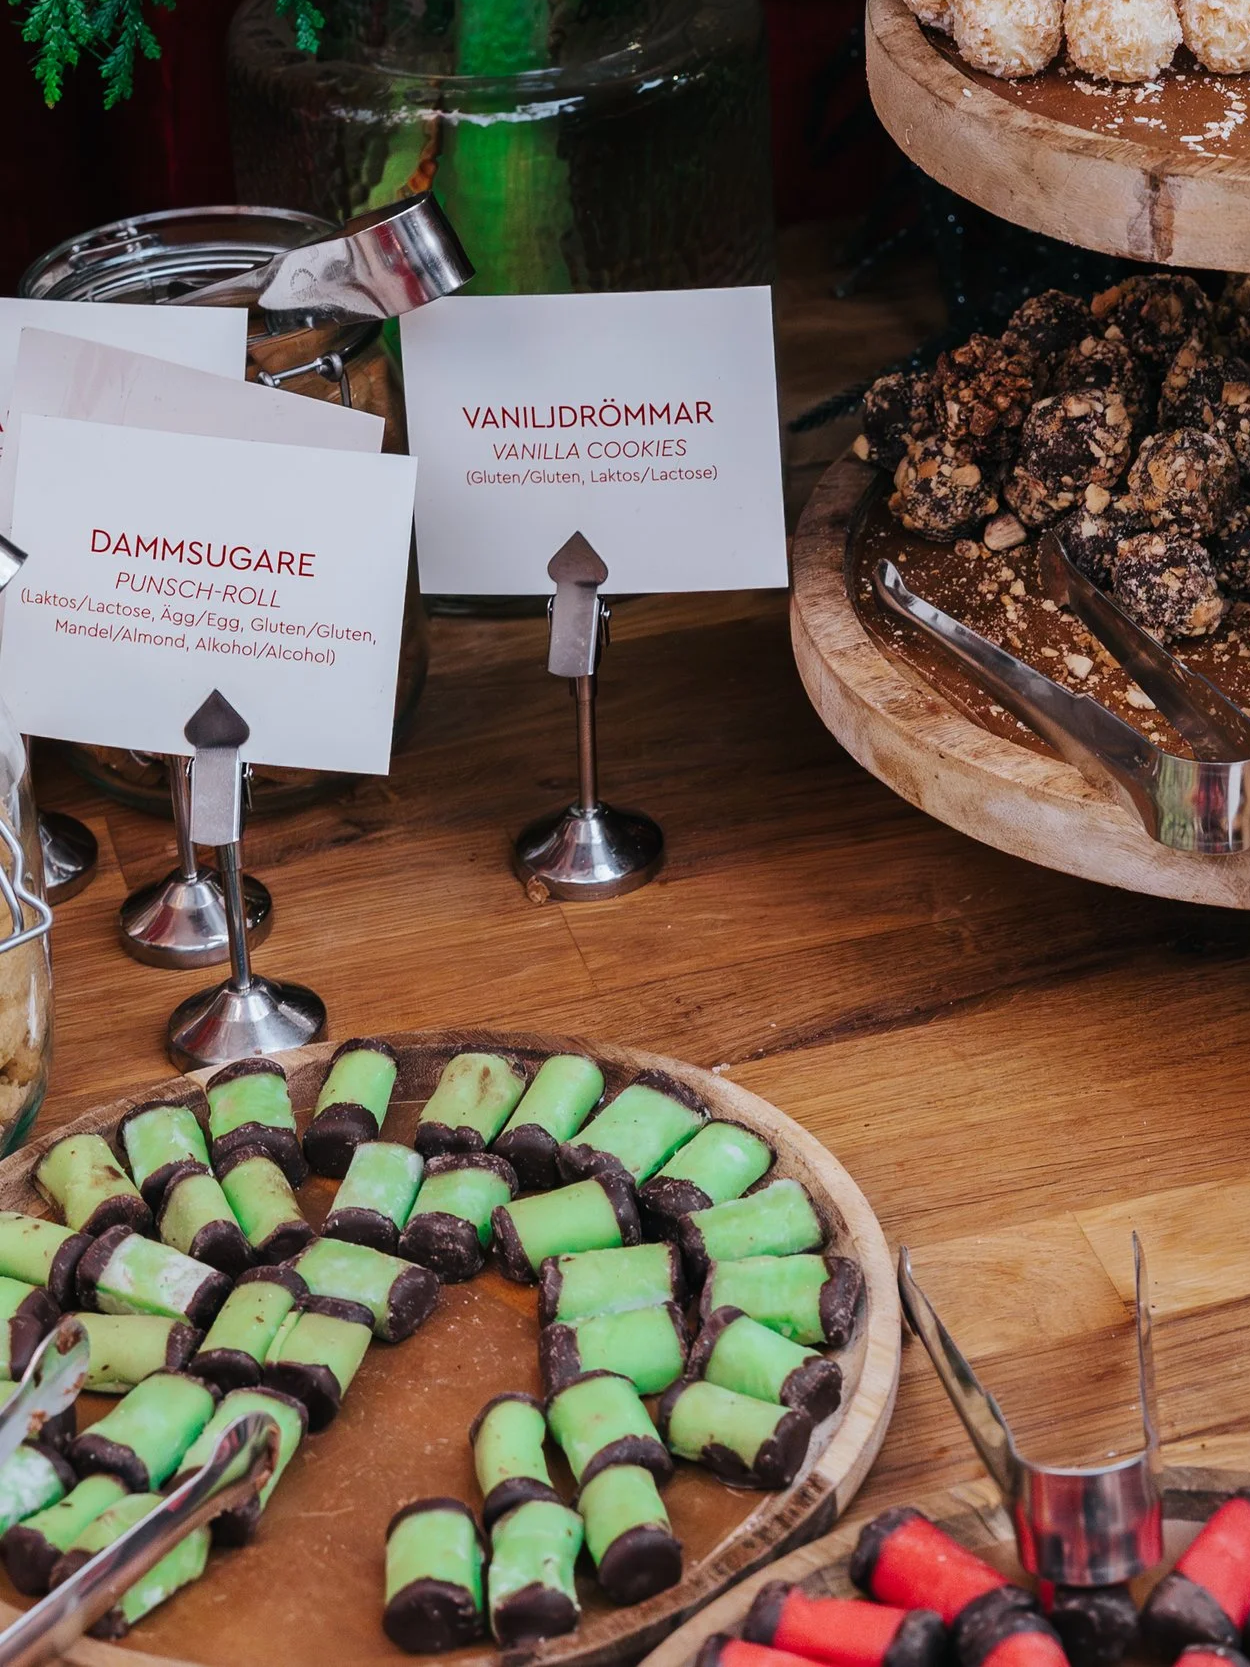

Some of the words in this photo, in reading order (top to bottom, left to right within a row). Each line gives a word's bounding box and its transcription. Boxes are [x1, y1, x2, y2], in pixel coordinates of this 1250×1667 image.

[462, 398, 714, 429] VANILJDRÖMMAR
[493, 442, 580, 460] VANILLA
[587, 439, 687, 459] COOKIES
[466, 469, 585, 485] (Gluten/Gluten,
[590, 465, 718, 483] Laktos/Lactose)
[90, 528, 316, 577] DAMMSUGARE
[115, 571, 281, 608] PUNSCH-ROLL
[20, 587, 155, 622] (Laktos/Lactose,
[160, 604, 245, 633] Ägg/Egg,
[250, 617, 377, 645] Gluten/Gluten,
[55, 618, 190, 652] Mandel/Almond,
[195, 636, 336, 666] Alkohol/Alcohol)
